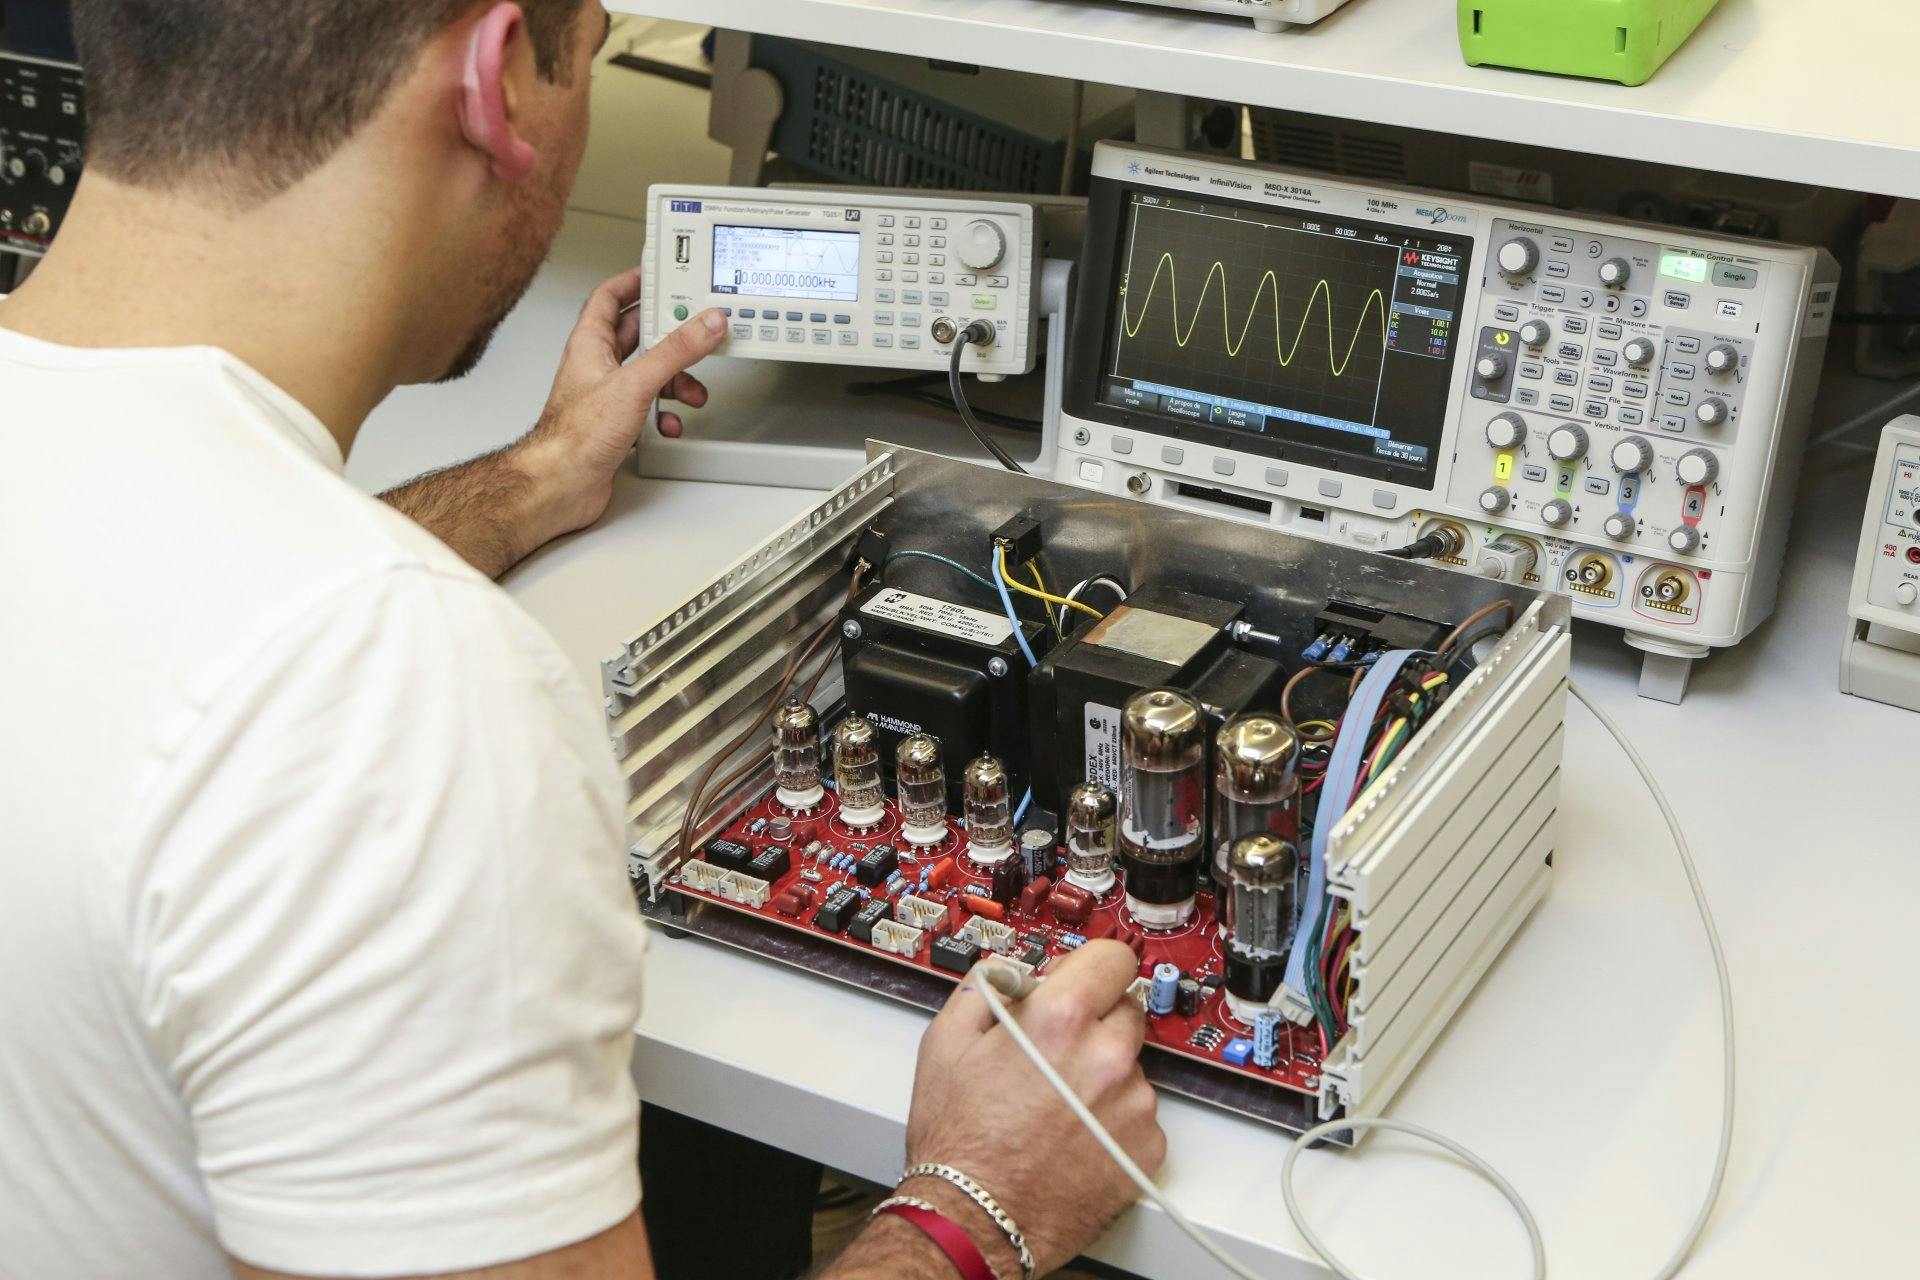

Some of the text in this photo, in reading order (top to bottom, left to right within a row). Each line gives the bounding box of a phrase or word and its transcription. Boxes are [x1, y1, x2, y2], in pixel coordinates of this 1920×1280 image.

[1145, 166, 1200, 182] Agilent Technologies
[1210, 178, 1252, 190] InfiniiVision
[1264, 182, 1312, 196] MSO-X 3014A
[1368, 198, 1398, 210] 100 MHz
[1508, 223, 1544, 234] Horizontal
[1374, 234, 1388, 243] Auto
[1421, 254, 1458, 266] KEYSIGHT
[1690, 250, 1734, 262] Run Control
[1421, 262, 1456, 272] TECHNOLOGIES
[1548, 265, 1565, 273] Search
[1413, 269, 1443, 280] Acquisition
[1724, 272, 1746, 282] Single
[1416, 278, 1437, 289] Normal
[1532, 304, 1555, 312] Trigger
[1616, 318, 1646, 328] Measure
[1600, 328, 1618, 336] Cursors
[1528, 346, 1543, 354] Level
[1542, 356, 1560, 365] Tools
[1602, 368, 1638, 379] Waveform
[1628, 364, 1650, 373] Cursors
[1673, 368, 1690, 376] Digital
[1624, 386, 1644, 394] Display
[1126, 398, 1140, 406] route
[1175, 399, 1192, 408] propos
[1608, 396, 1620, 404] File
[1228, 408, 1247, 418] Langue
[1228, 417, 1246, 426] French
[1594, 420, 1621, 432] Vertical
[1408, 453, 1423, 462] jours
[1500, 462, 1506, 473] 1
[1560, 474, 1569, 486] 2
[1624, 487, 1632, 498] 3
[1688, 500, 1697, 511] 4
[1884, 544, 1898, 552] 400
[891, 613, 915, 622] CANADA
[880, 714, 922, 732] HAMMOND
